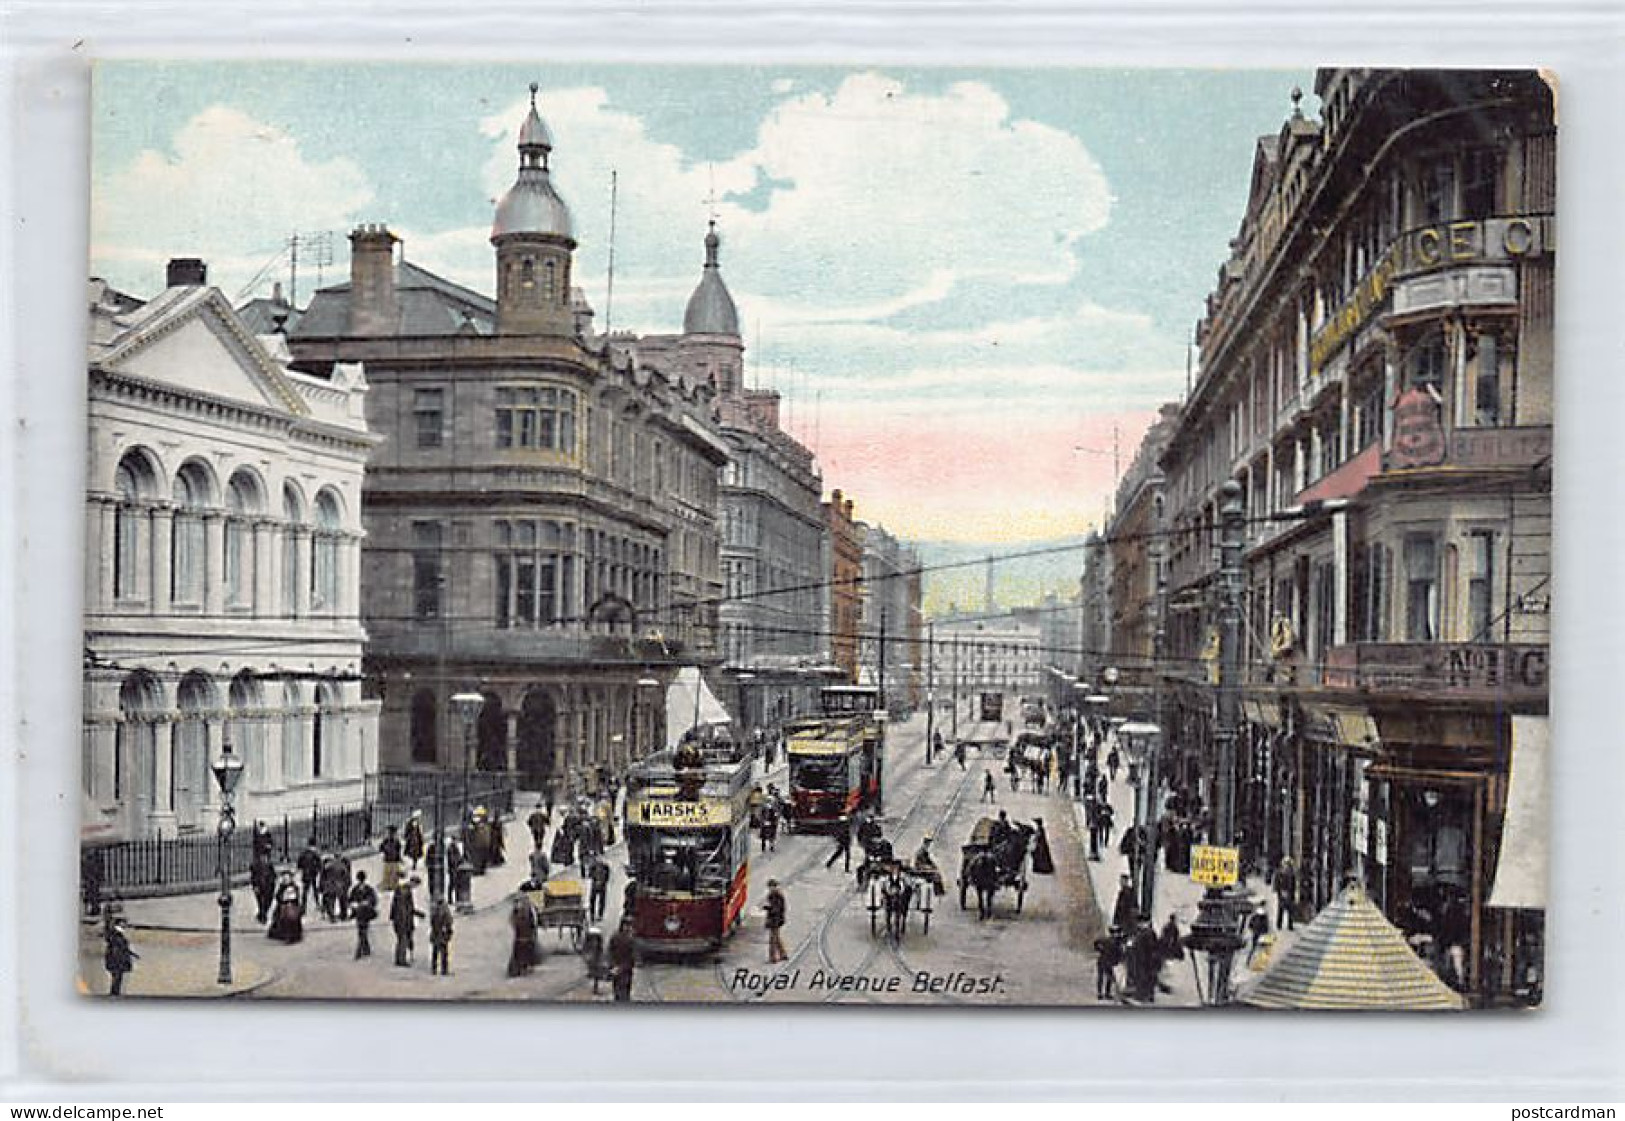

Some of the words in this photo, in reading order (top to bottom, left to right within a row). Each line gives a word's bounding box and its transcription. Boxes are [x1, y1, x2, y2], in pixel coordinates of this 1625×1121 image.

[732, 969, 800, 997] Royal
[809, 970, 901, 993] Avenue
[912, 971, 1006, 994] Belfast.
